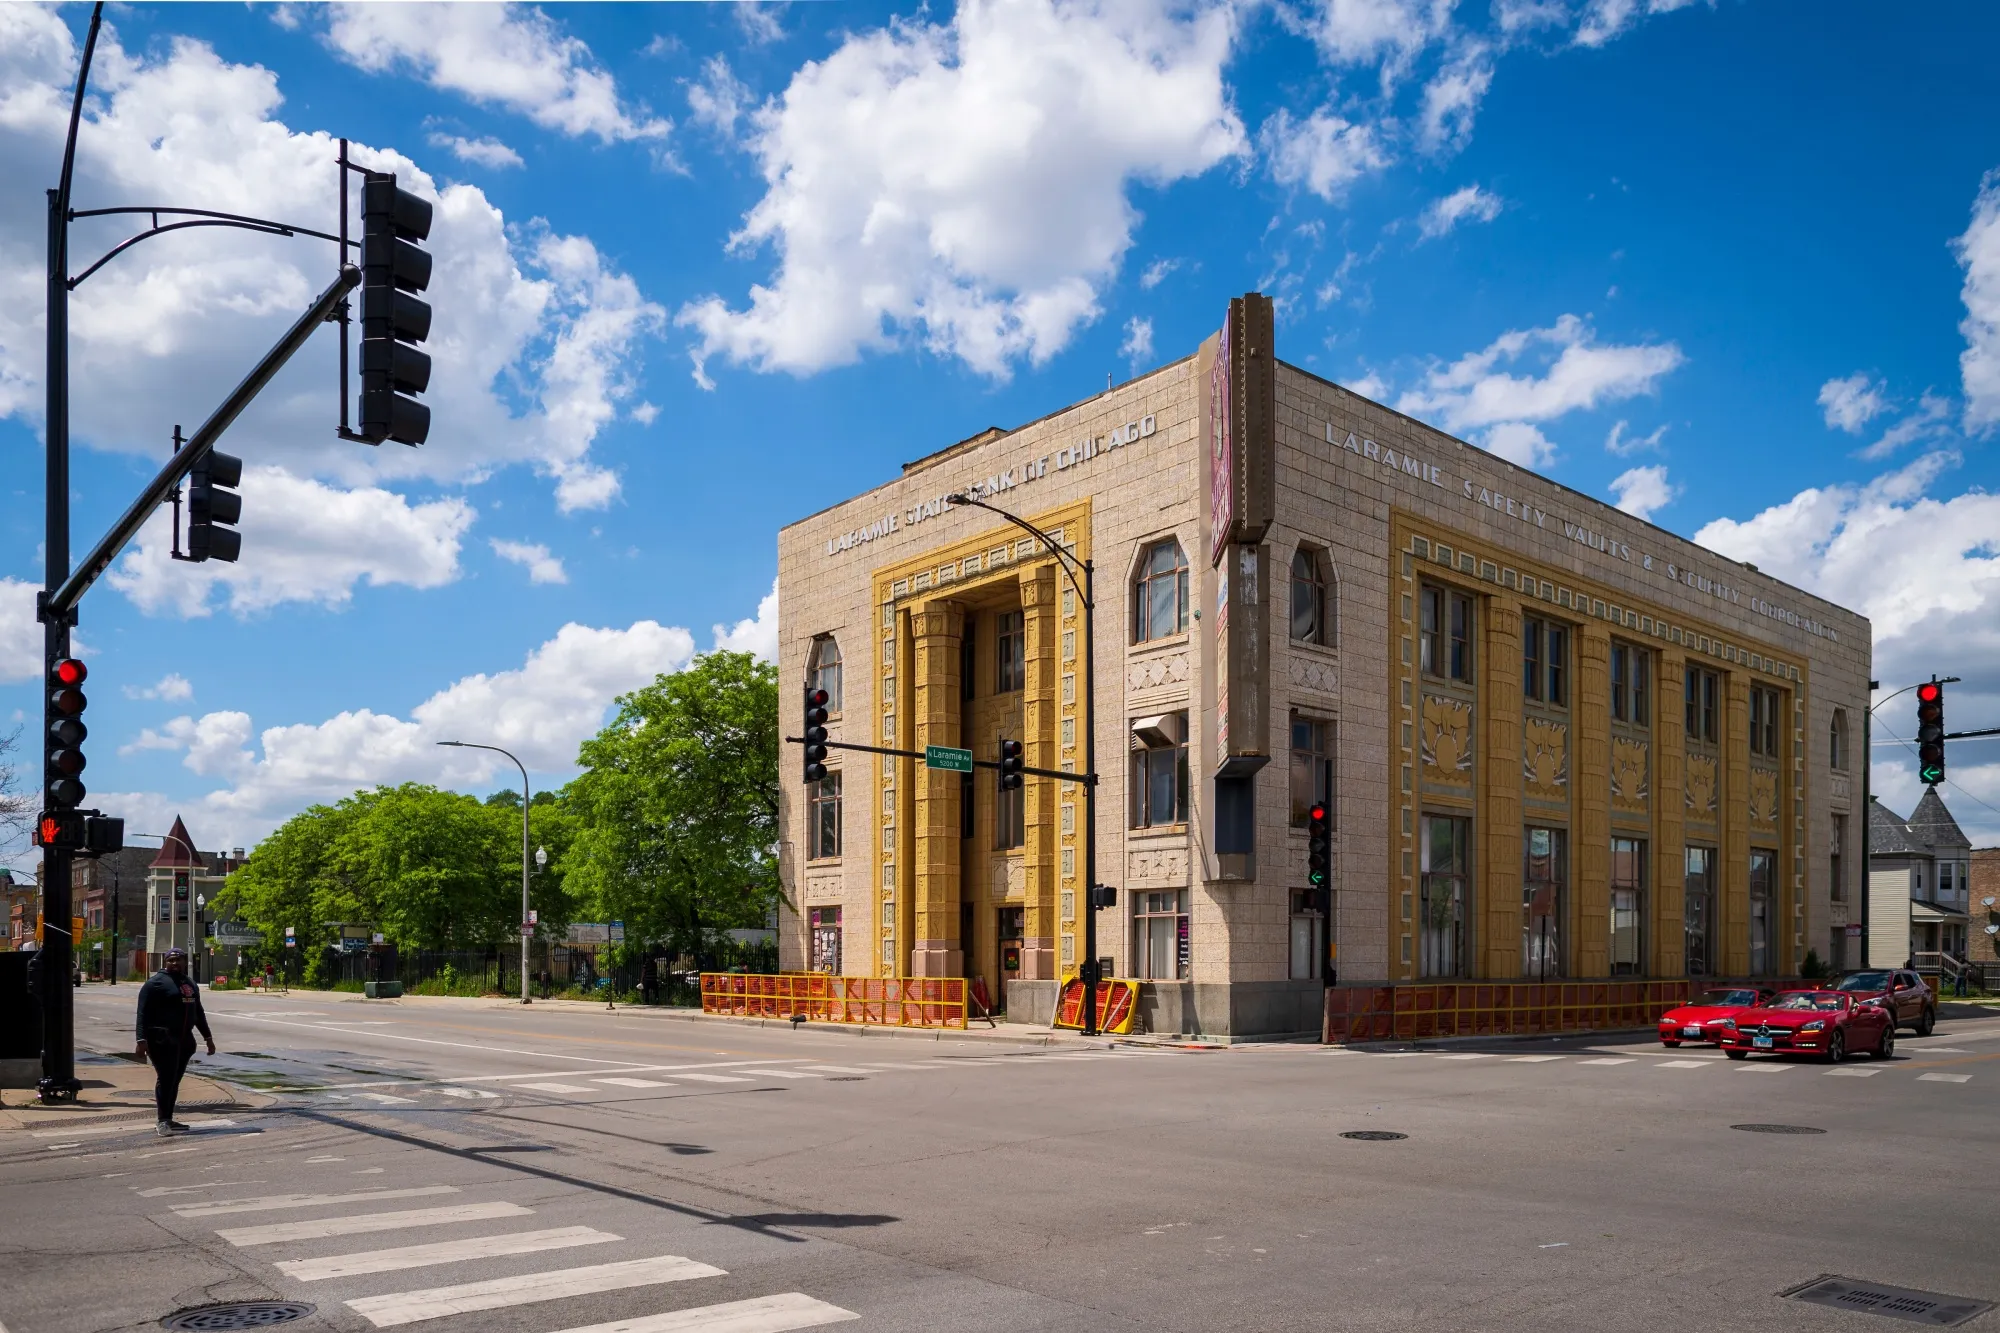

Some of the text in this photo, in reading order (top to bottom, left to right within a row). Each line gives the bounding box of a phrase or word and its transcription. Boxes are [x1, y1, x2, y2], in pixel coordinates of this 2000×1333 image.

[828, 514, 900, 556] LARAMIE
[1022, 455, 1049, 482] OF
[1056, 413, 1156, 469] CHICAGO
[1325, 422, 1444, 489] LARAMIE
[1462, 479, 1547, 528] SAFETY
[1643, 554, 1653, 571] &
[933, 749, 962, 760] Laramie
